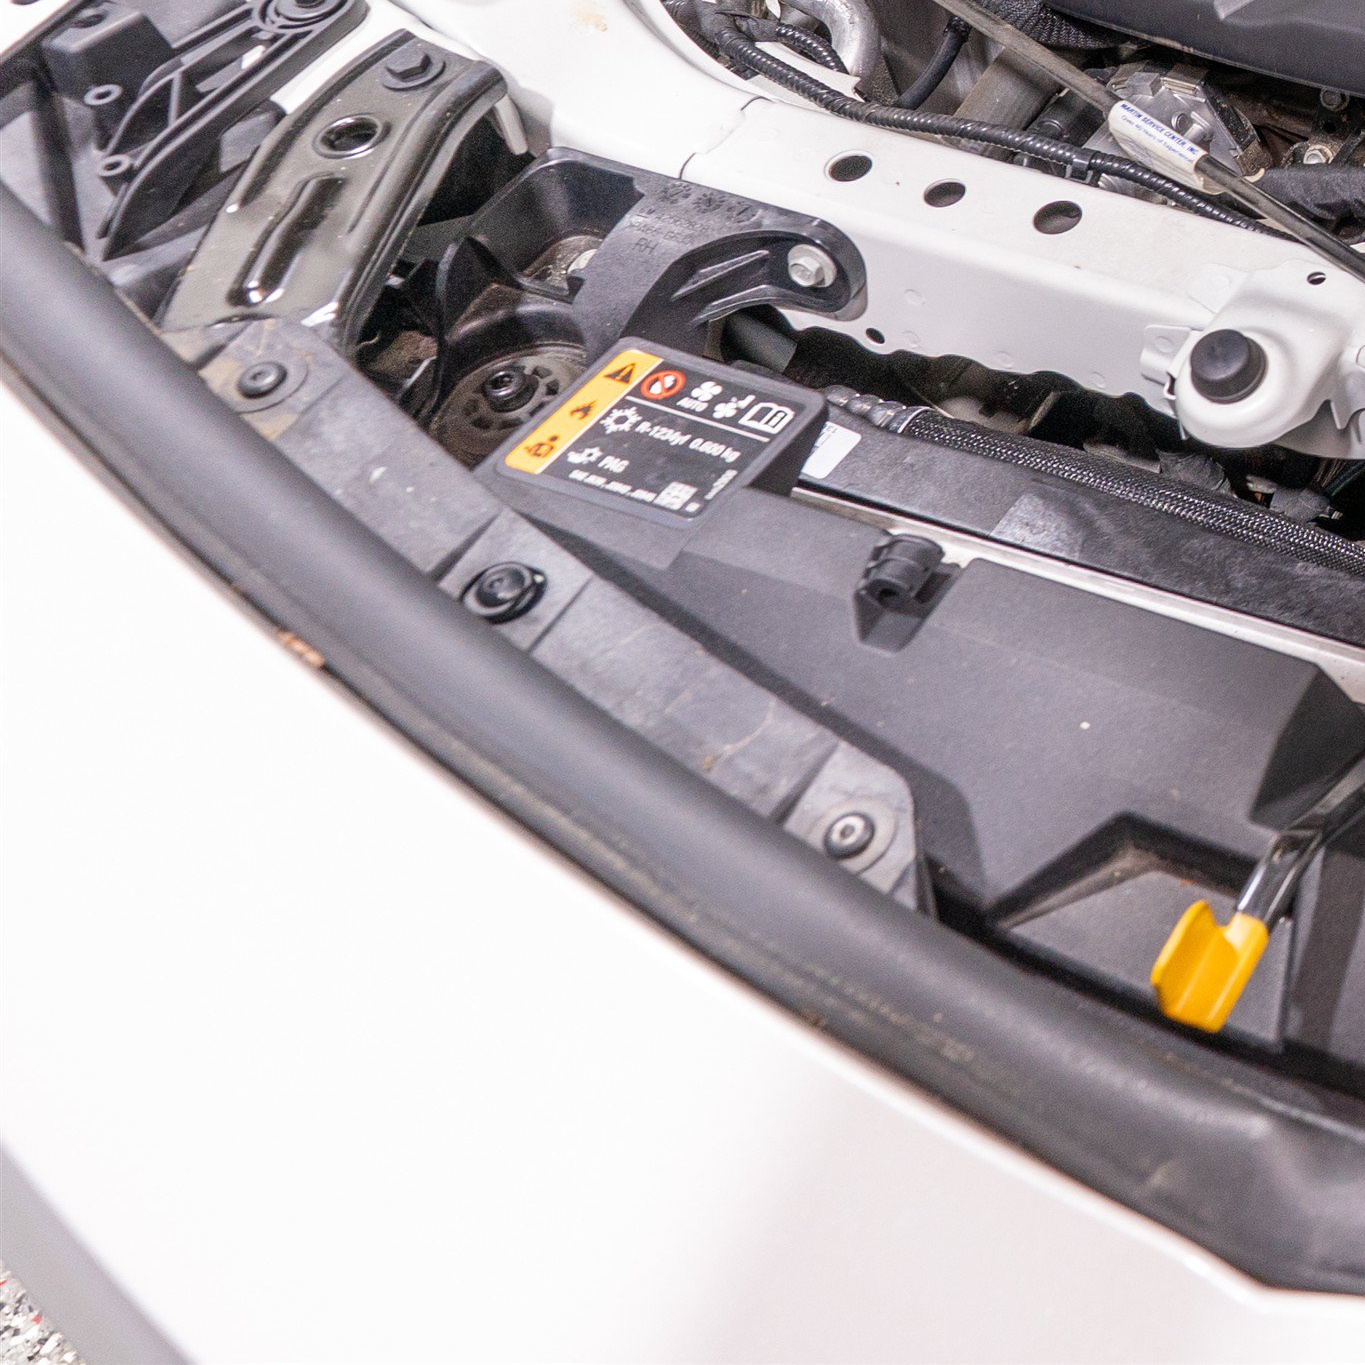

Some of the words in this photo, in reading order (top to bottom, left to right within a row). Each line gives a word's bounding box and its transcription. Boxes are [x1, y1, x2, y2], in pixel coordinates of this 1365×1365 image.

[1121, 103, 1143, 119] MARTIN
[1142, 116, 1165, 133] SERVICE
[632, 237, 659, 255] RH
[676, 396, 709, 413] AUTO
[598, 455, 630, 473] PAG
